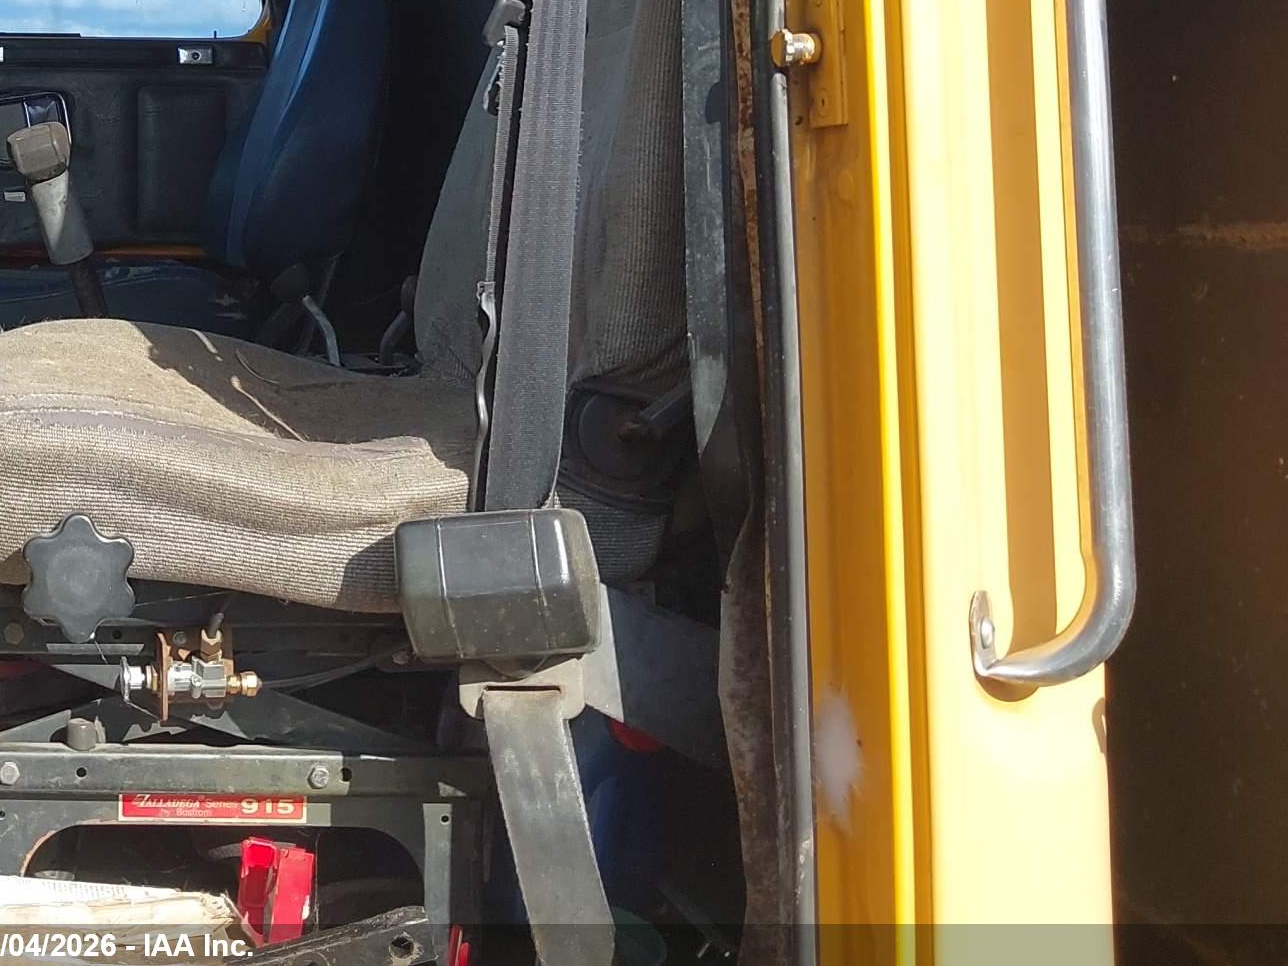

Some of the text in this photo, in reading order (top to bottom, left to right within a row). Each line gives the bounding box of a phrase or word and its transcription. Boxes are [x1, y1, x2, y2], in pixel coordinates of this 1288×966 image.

[205, 799, 238, 809] Series
[241, 798, 294, 814] 915
[176, 808, 212, 817] Bostrom
